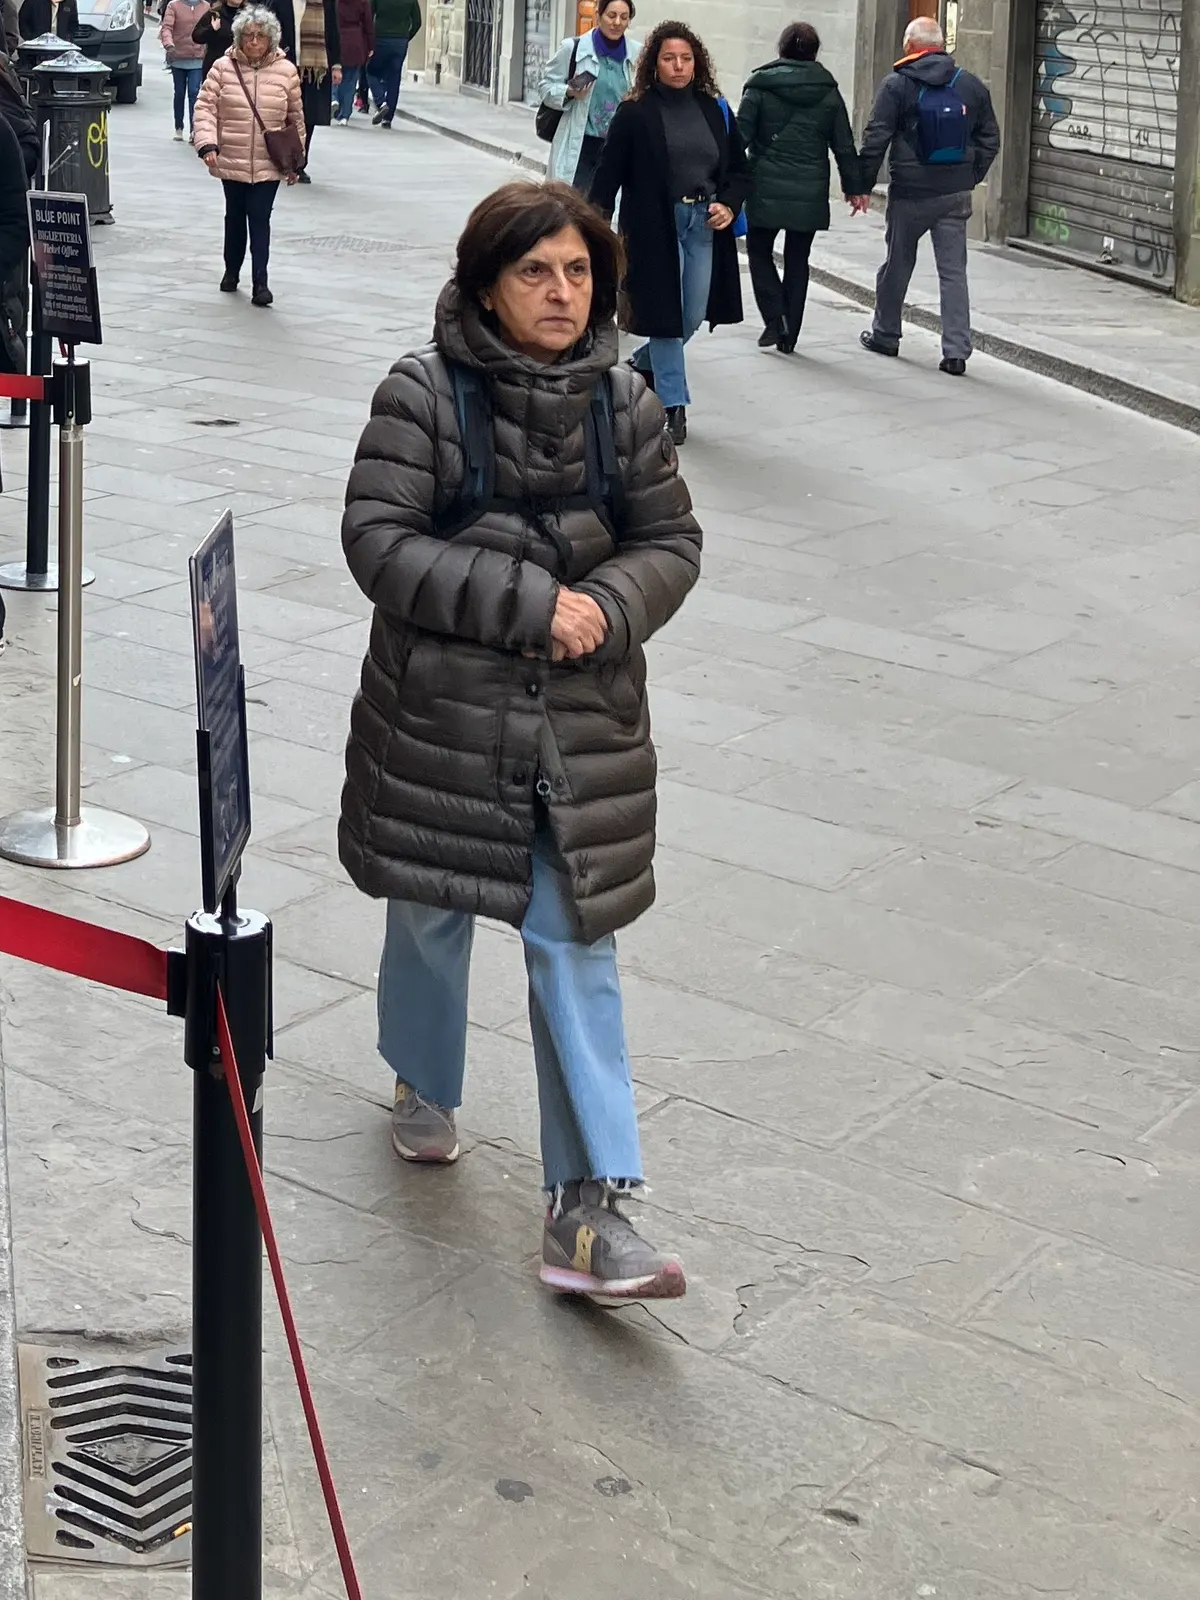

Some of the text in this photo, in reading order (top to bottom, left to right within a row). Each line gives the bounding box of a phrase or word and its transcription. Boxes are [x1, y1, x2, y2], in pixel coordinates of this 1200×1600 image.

[35, 209, 81, 226] BLUE POINT
[37, 229, 83, 245] BIGLIETTERIA
[43, 243, 80, 258] Ticket Office
